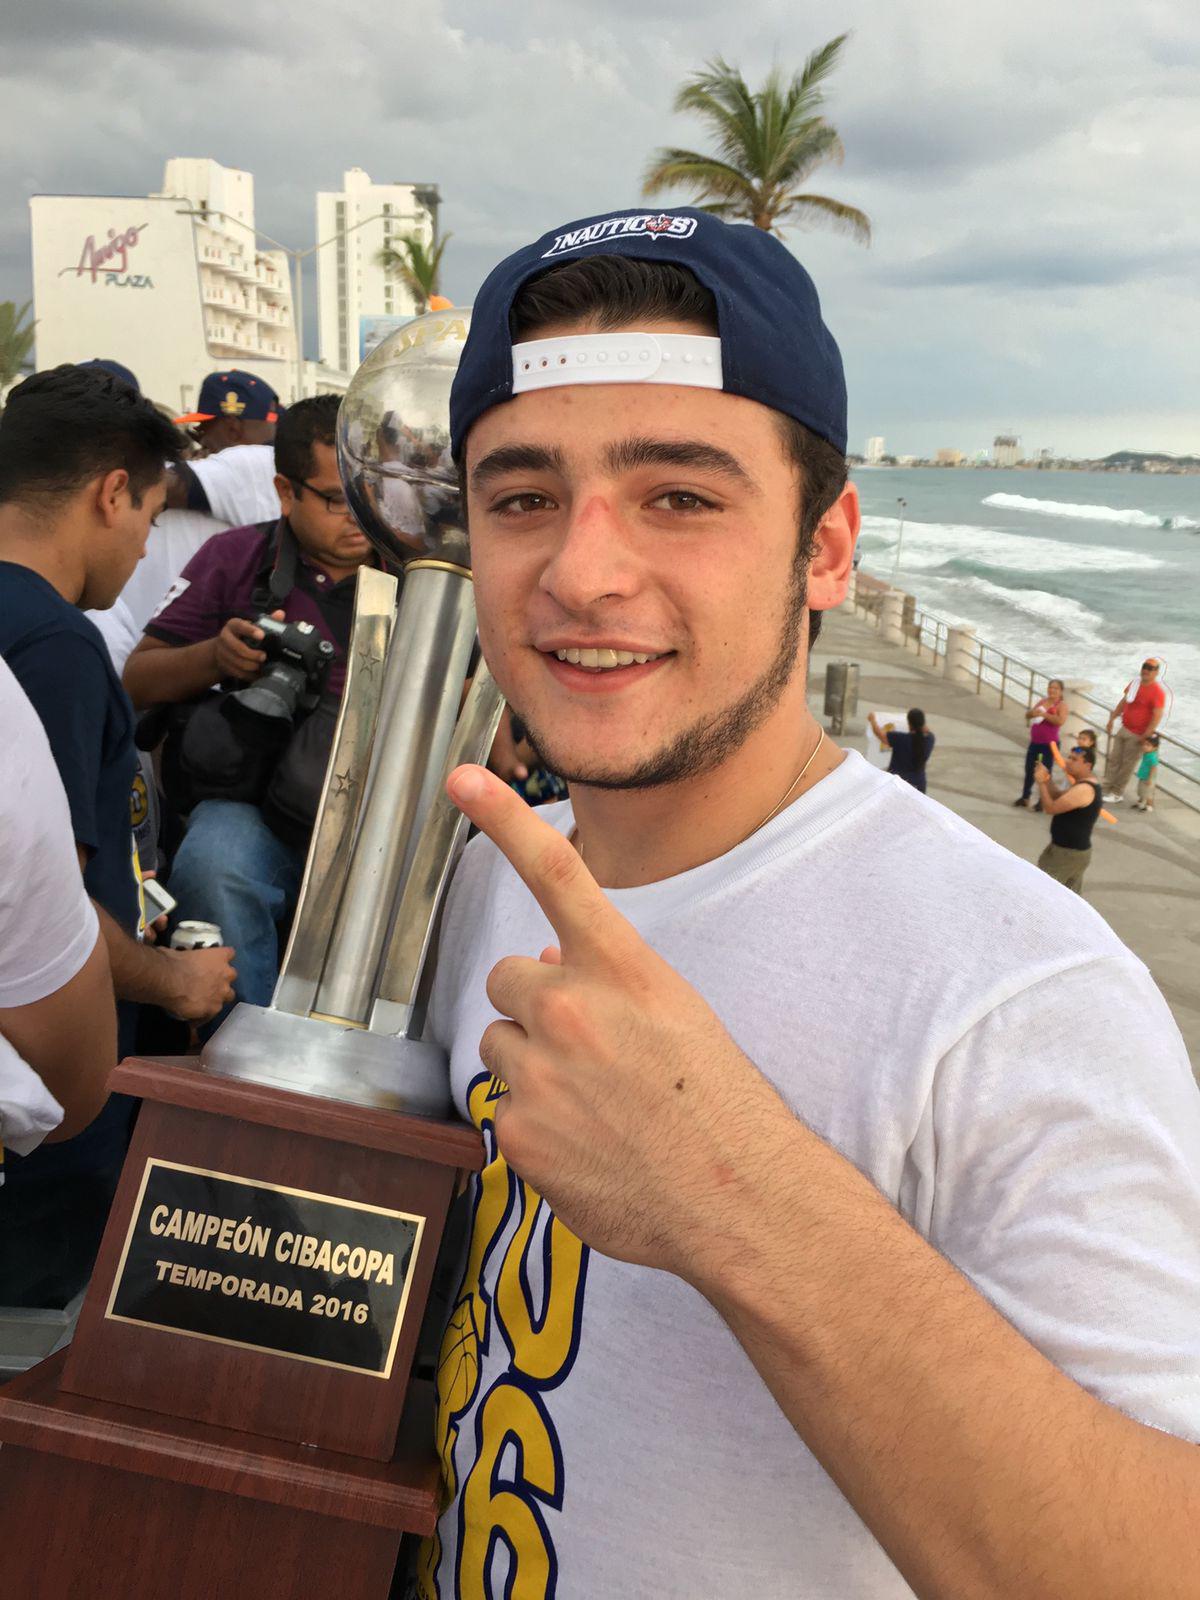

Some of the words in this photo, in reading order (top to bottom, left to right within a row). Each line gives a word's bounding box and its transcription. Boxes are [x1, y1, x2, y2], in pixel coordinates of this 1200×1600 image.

[105, 273, 155, 288] PLAZA
[150, 1204, 271, 1258] CAMPEÓN
[275, 1231, 395, 1285] CIBACOPA
[155, 1260, 303, 1311] TEMPORADA
[309, 1295, 369, 1324] 2016
